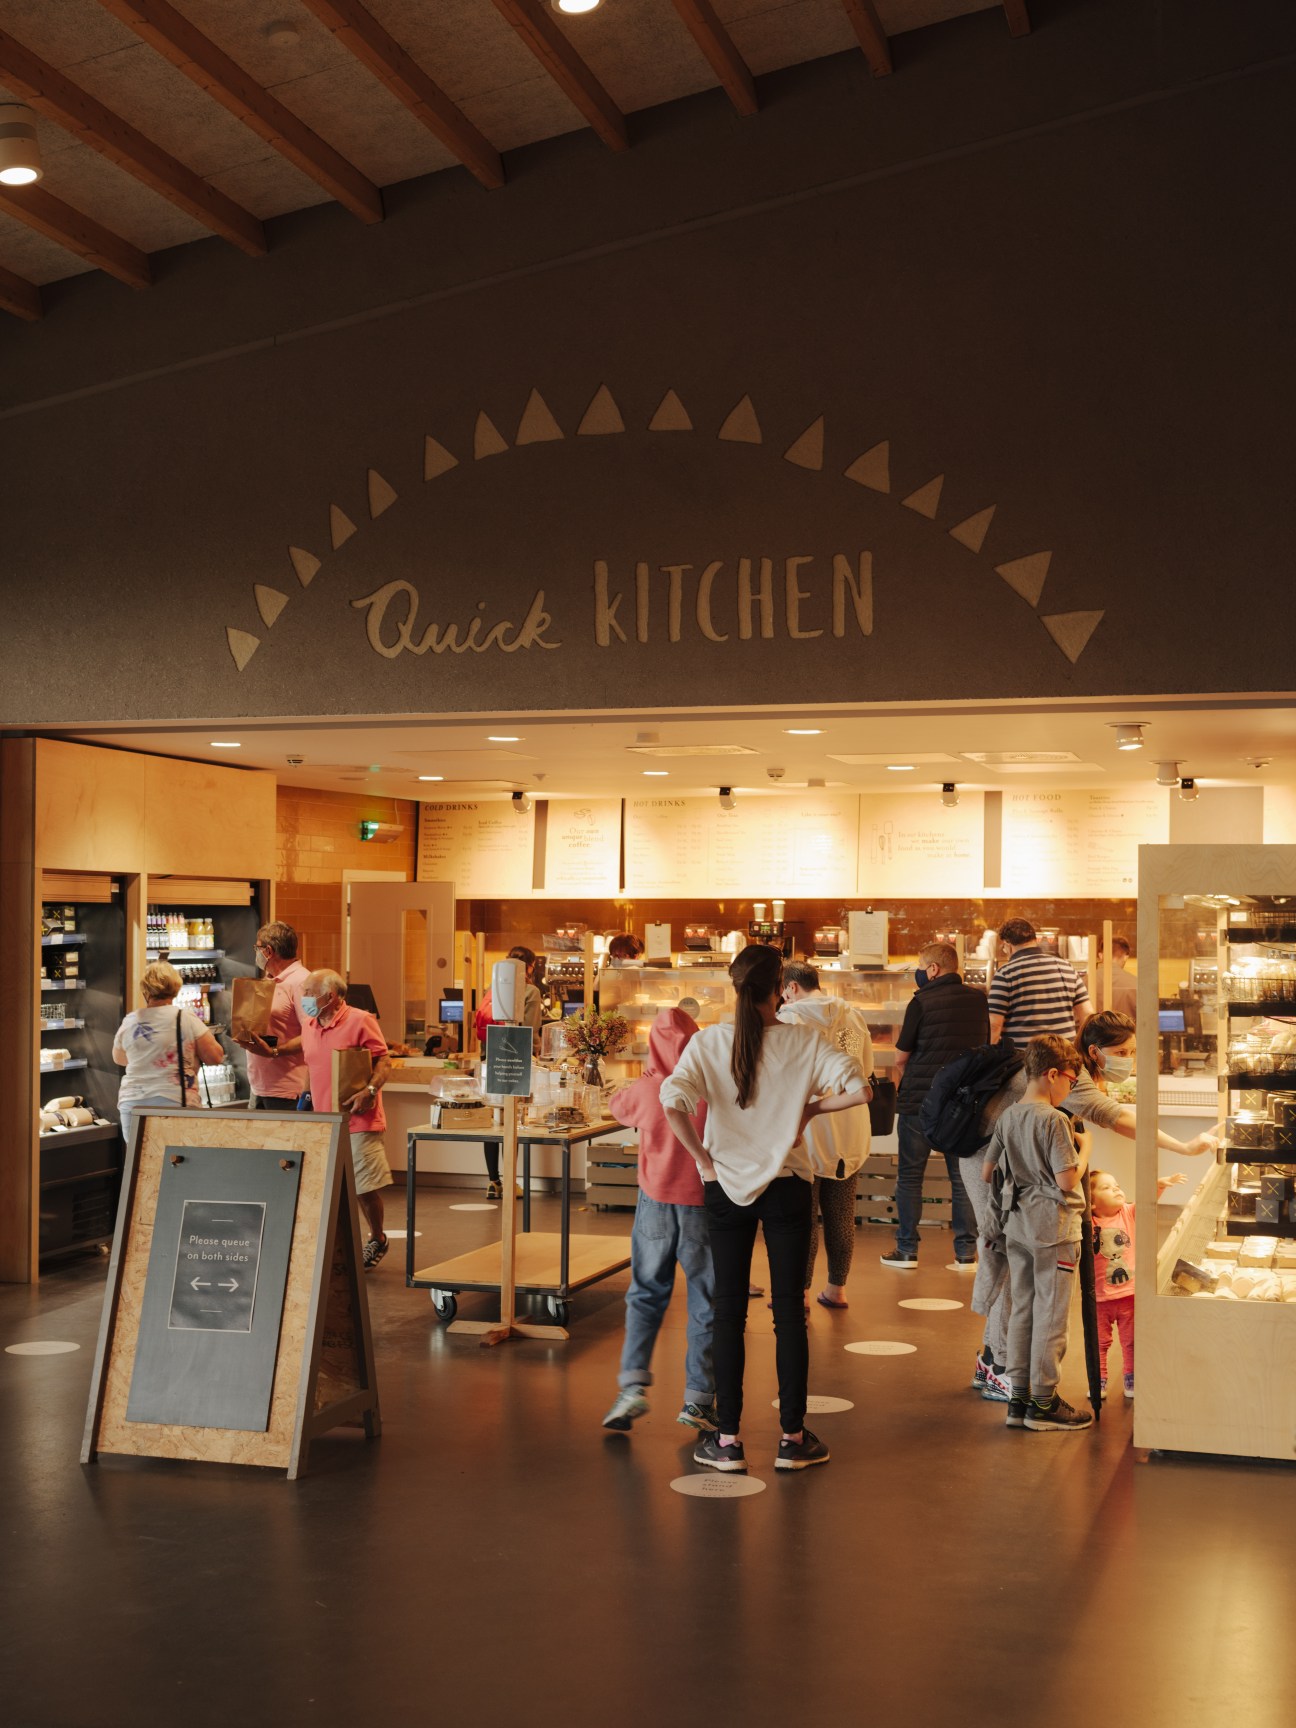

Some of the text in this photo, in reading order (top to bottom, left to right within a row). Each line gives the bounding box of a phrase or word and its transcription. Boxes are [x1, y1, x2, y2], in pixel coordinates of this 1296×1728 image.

[352, 579, 562, 658] Quick
[1033, 793, 1061, 801] FOOD
[445, 803, 478, 811] DRINKS
[189, 1235, 250, 1248] Please queue
[187, 1251, 249, 1262] on both sides
